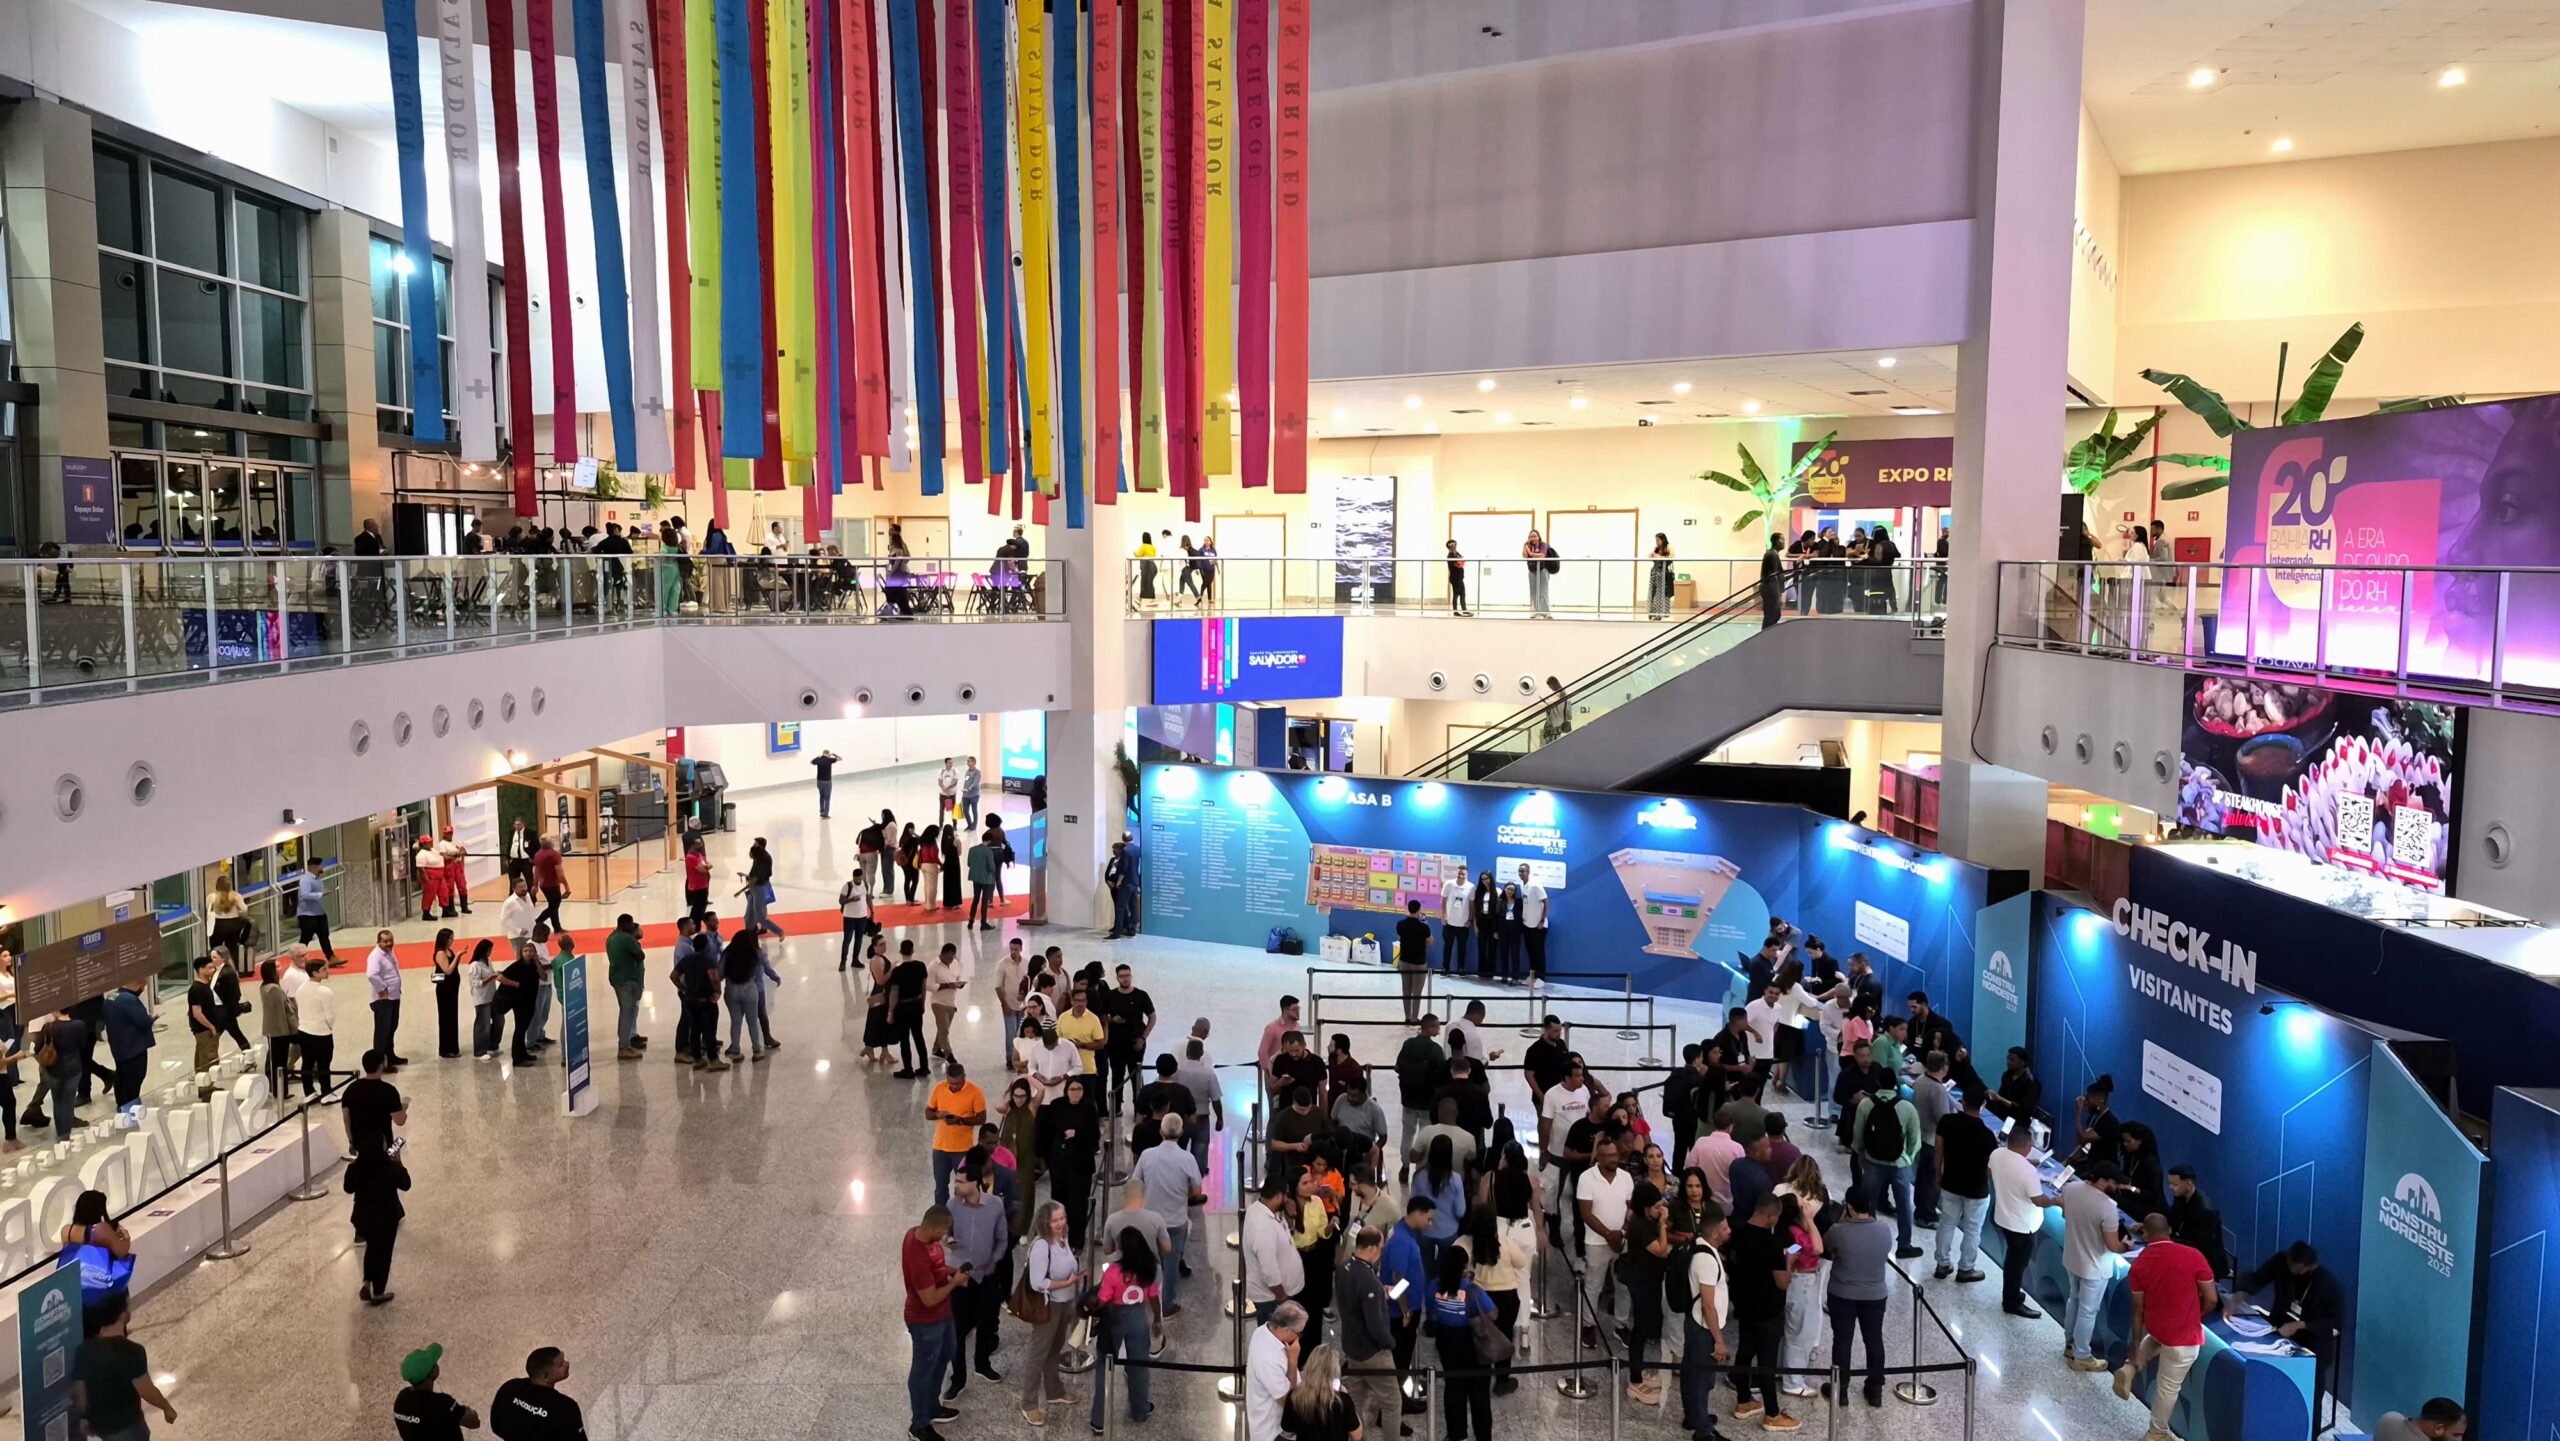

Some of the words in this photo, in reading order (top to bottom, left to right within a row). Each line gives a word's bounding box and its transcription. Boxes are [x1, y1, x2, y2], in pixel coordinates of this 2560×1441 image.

[1878, 468, 1930, 483] EXPO
[2271, 459, 2333, 527] 20
[2343, 528, 2354, 548] A
[2358, 528, 2386, 549] ERA
[2275, 567, 2322, 585] Inteligência
[2340, 580, 2363, 601] DO
[2367, 581, 2388, 601] RH
[1248, 652, 1299, 668] SALVADOR
[1347, 792, 1378, 806] ASA
[1381, 793, 1392, 807] B
[1543, 846, 1564, 855] 2025
[2113, 897, 2258, 995] CHECK-IN
[1982, 969, 2016, 994] CONSTRU
[1982, 979, 2019, 1006] NORDESTE
[2129, 963, 2233, 1035] VISITANTES
[2380, 1195, 2448, 1247] CONSTRU
[2379, 1209, 2455, 1268] NORDESTE
[2427, 1255, 2452, 1279] 2025
